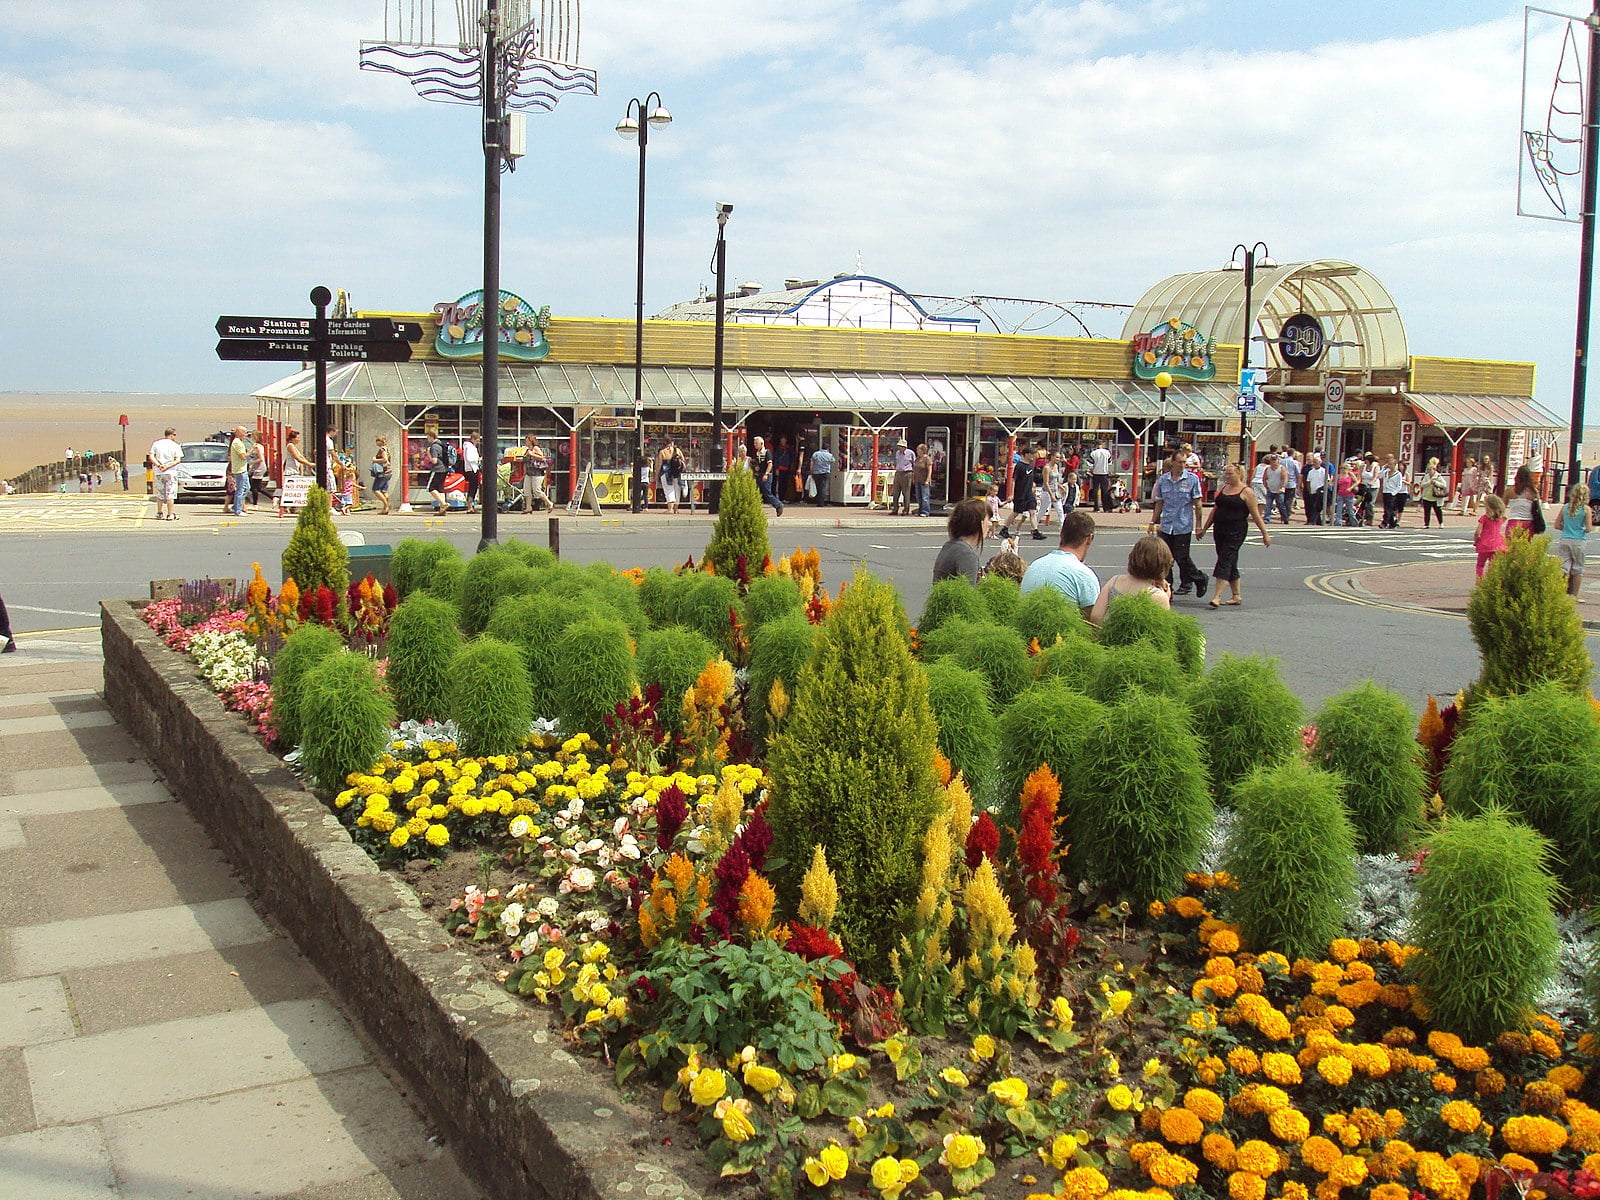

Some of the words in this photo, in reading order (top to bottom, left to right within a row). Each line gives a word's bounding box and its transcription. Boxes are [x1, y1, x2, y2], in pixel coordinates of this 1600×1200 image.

[434, 302, 480, 326] The
[263, 320, 298, 328] Station
[228, 325, 257, 334] North
[259, 327, 310, 335] Promenade
[268, 342, 309, 351] Parking
[1286, 325, 1322, 358] 39
[330, 343, 364, 351] Parking
[1329, 386, 1341, 396] 20
[1314, 424, 1325, 445] HOT
[1401, 424, 1413, 466] DONU
